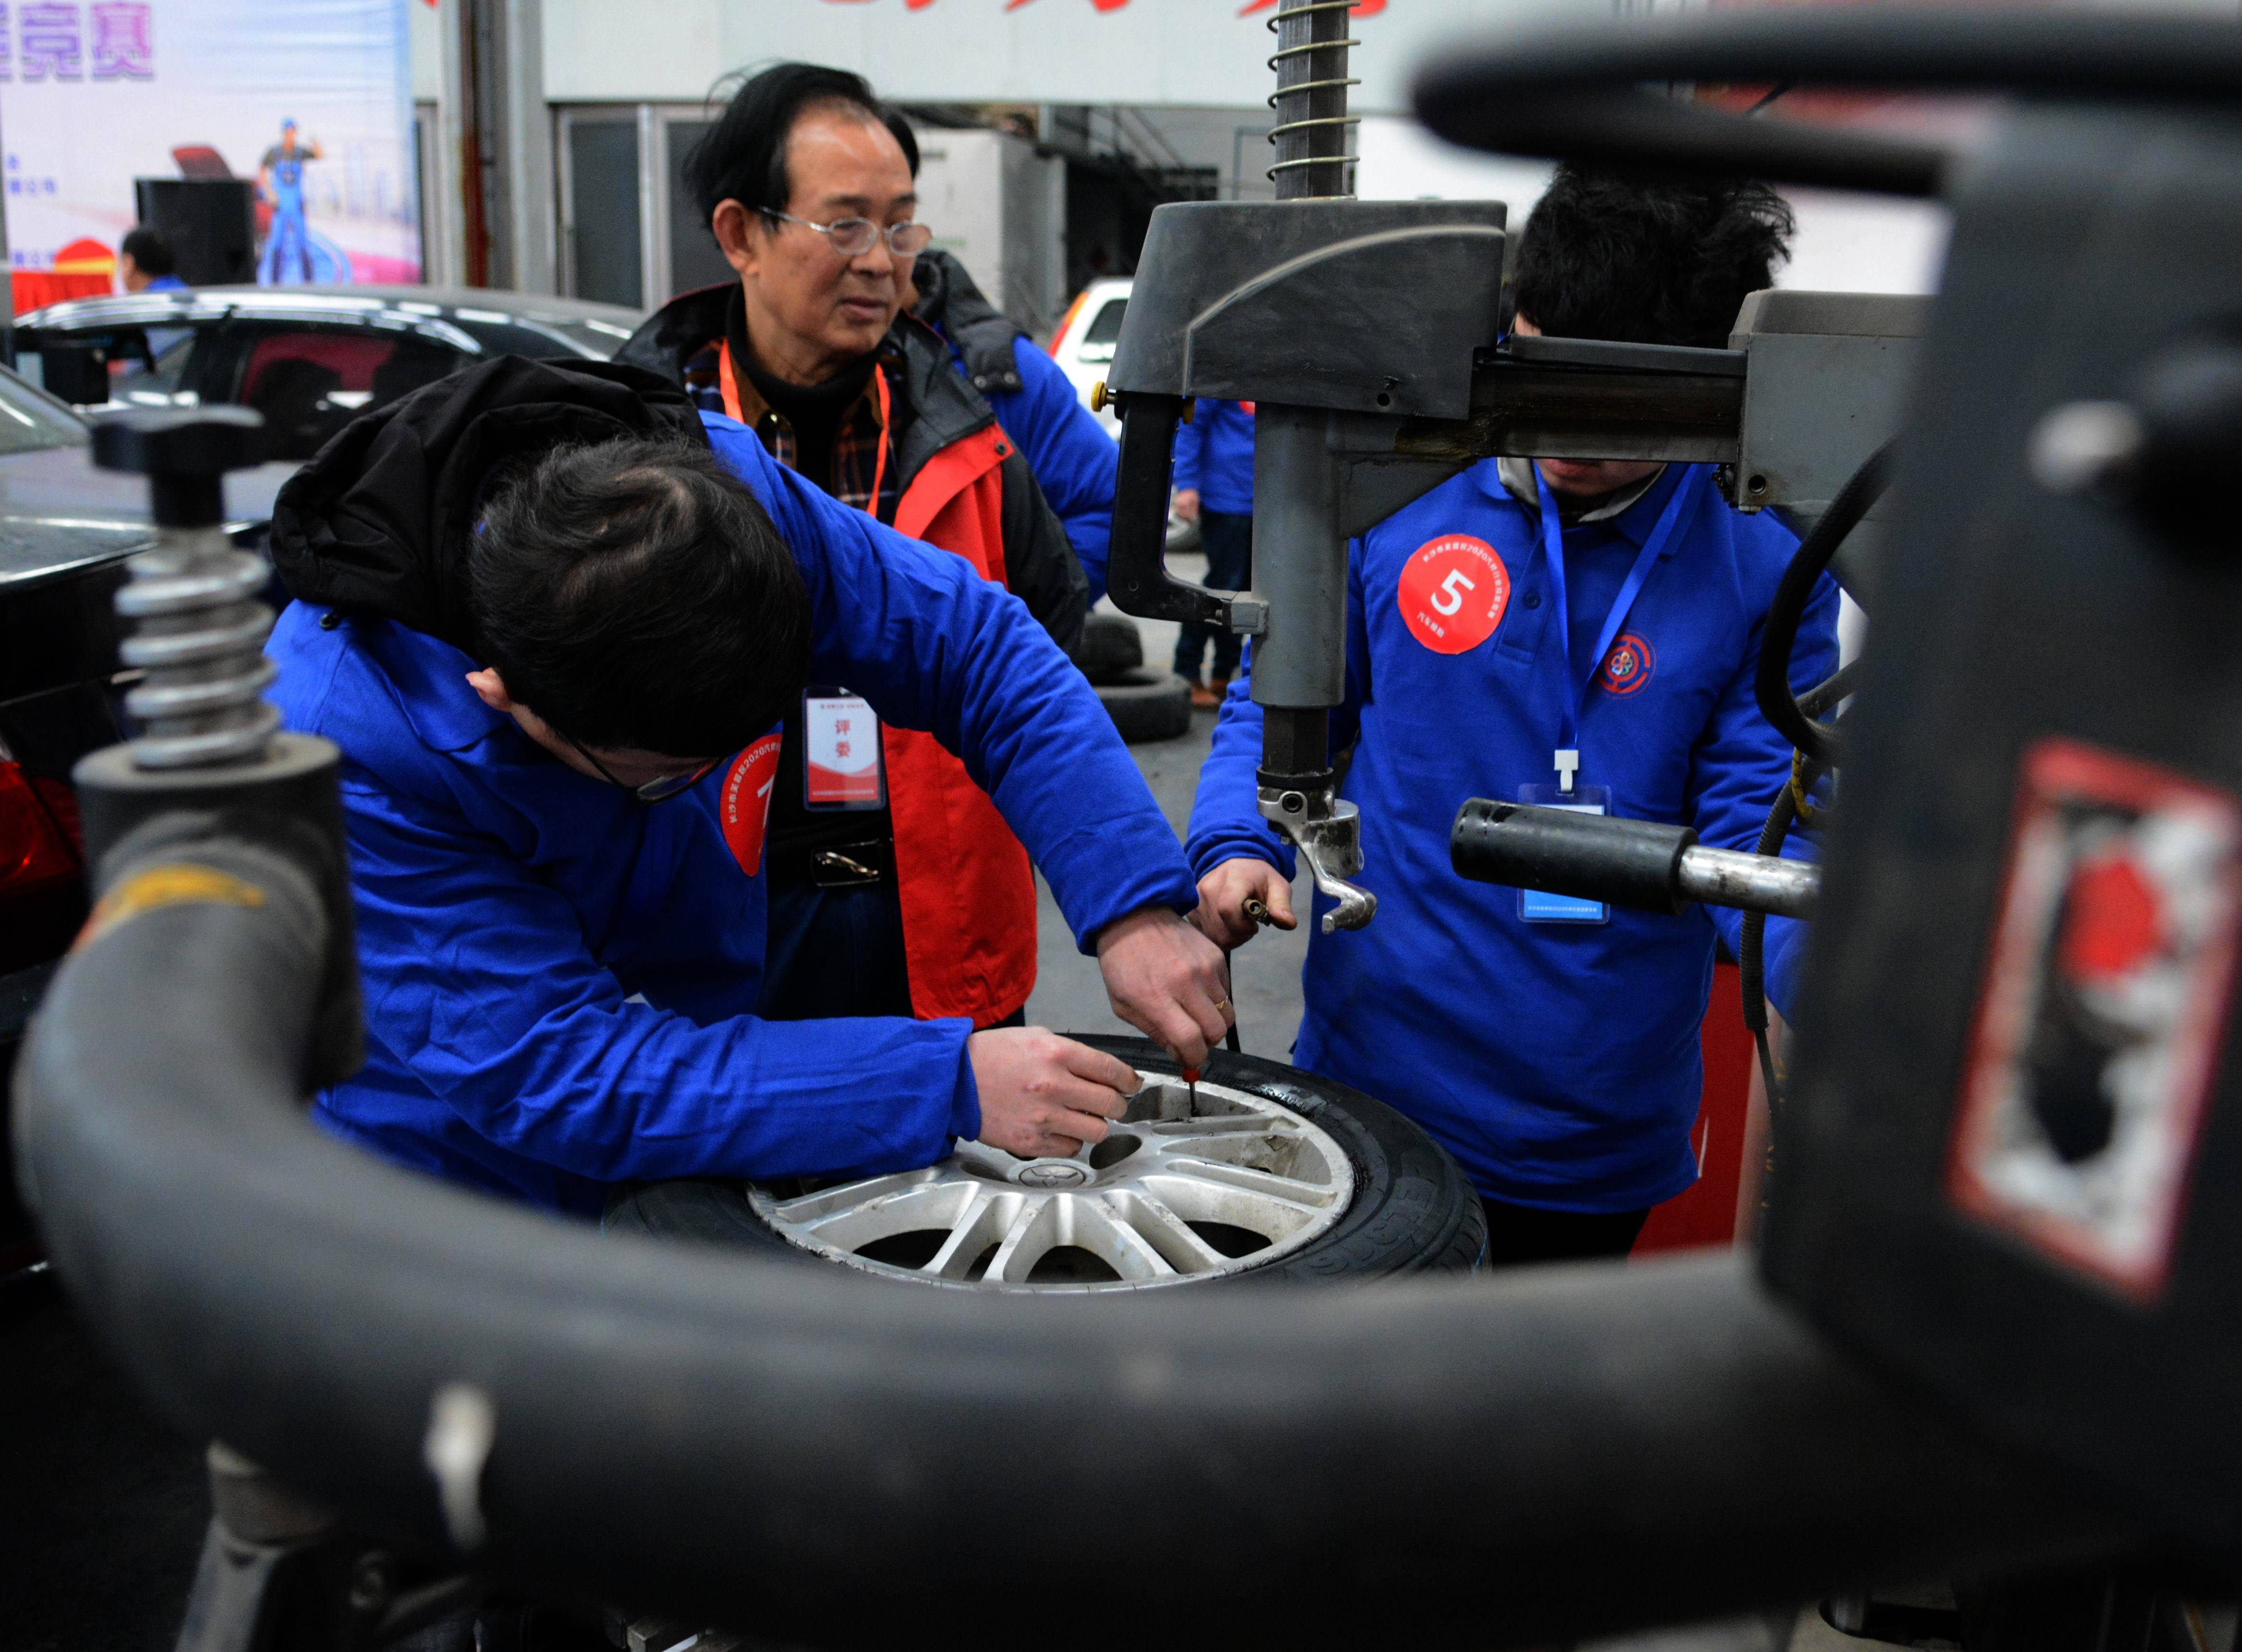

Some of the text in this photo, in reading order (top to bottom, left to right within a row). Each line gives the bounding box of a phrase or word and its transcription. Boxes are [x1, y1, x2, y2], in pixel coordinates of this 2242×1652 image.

[0, 1, 154, 80] 竞赛
[1431, 569, 1475, 616] 5
[835, 719, 851, 758] 评委
